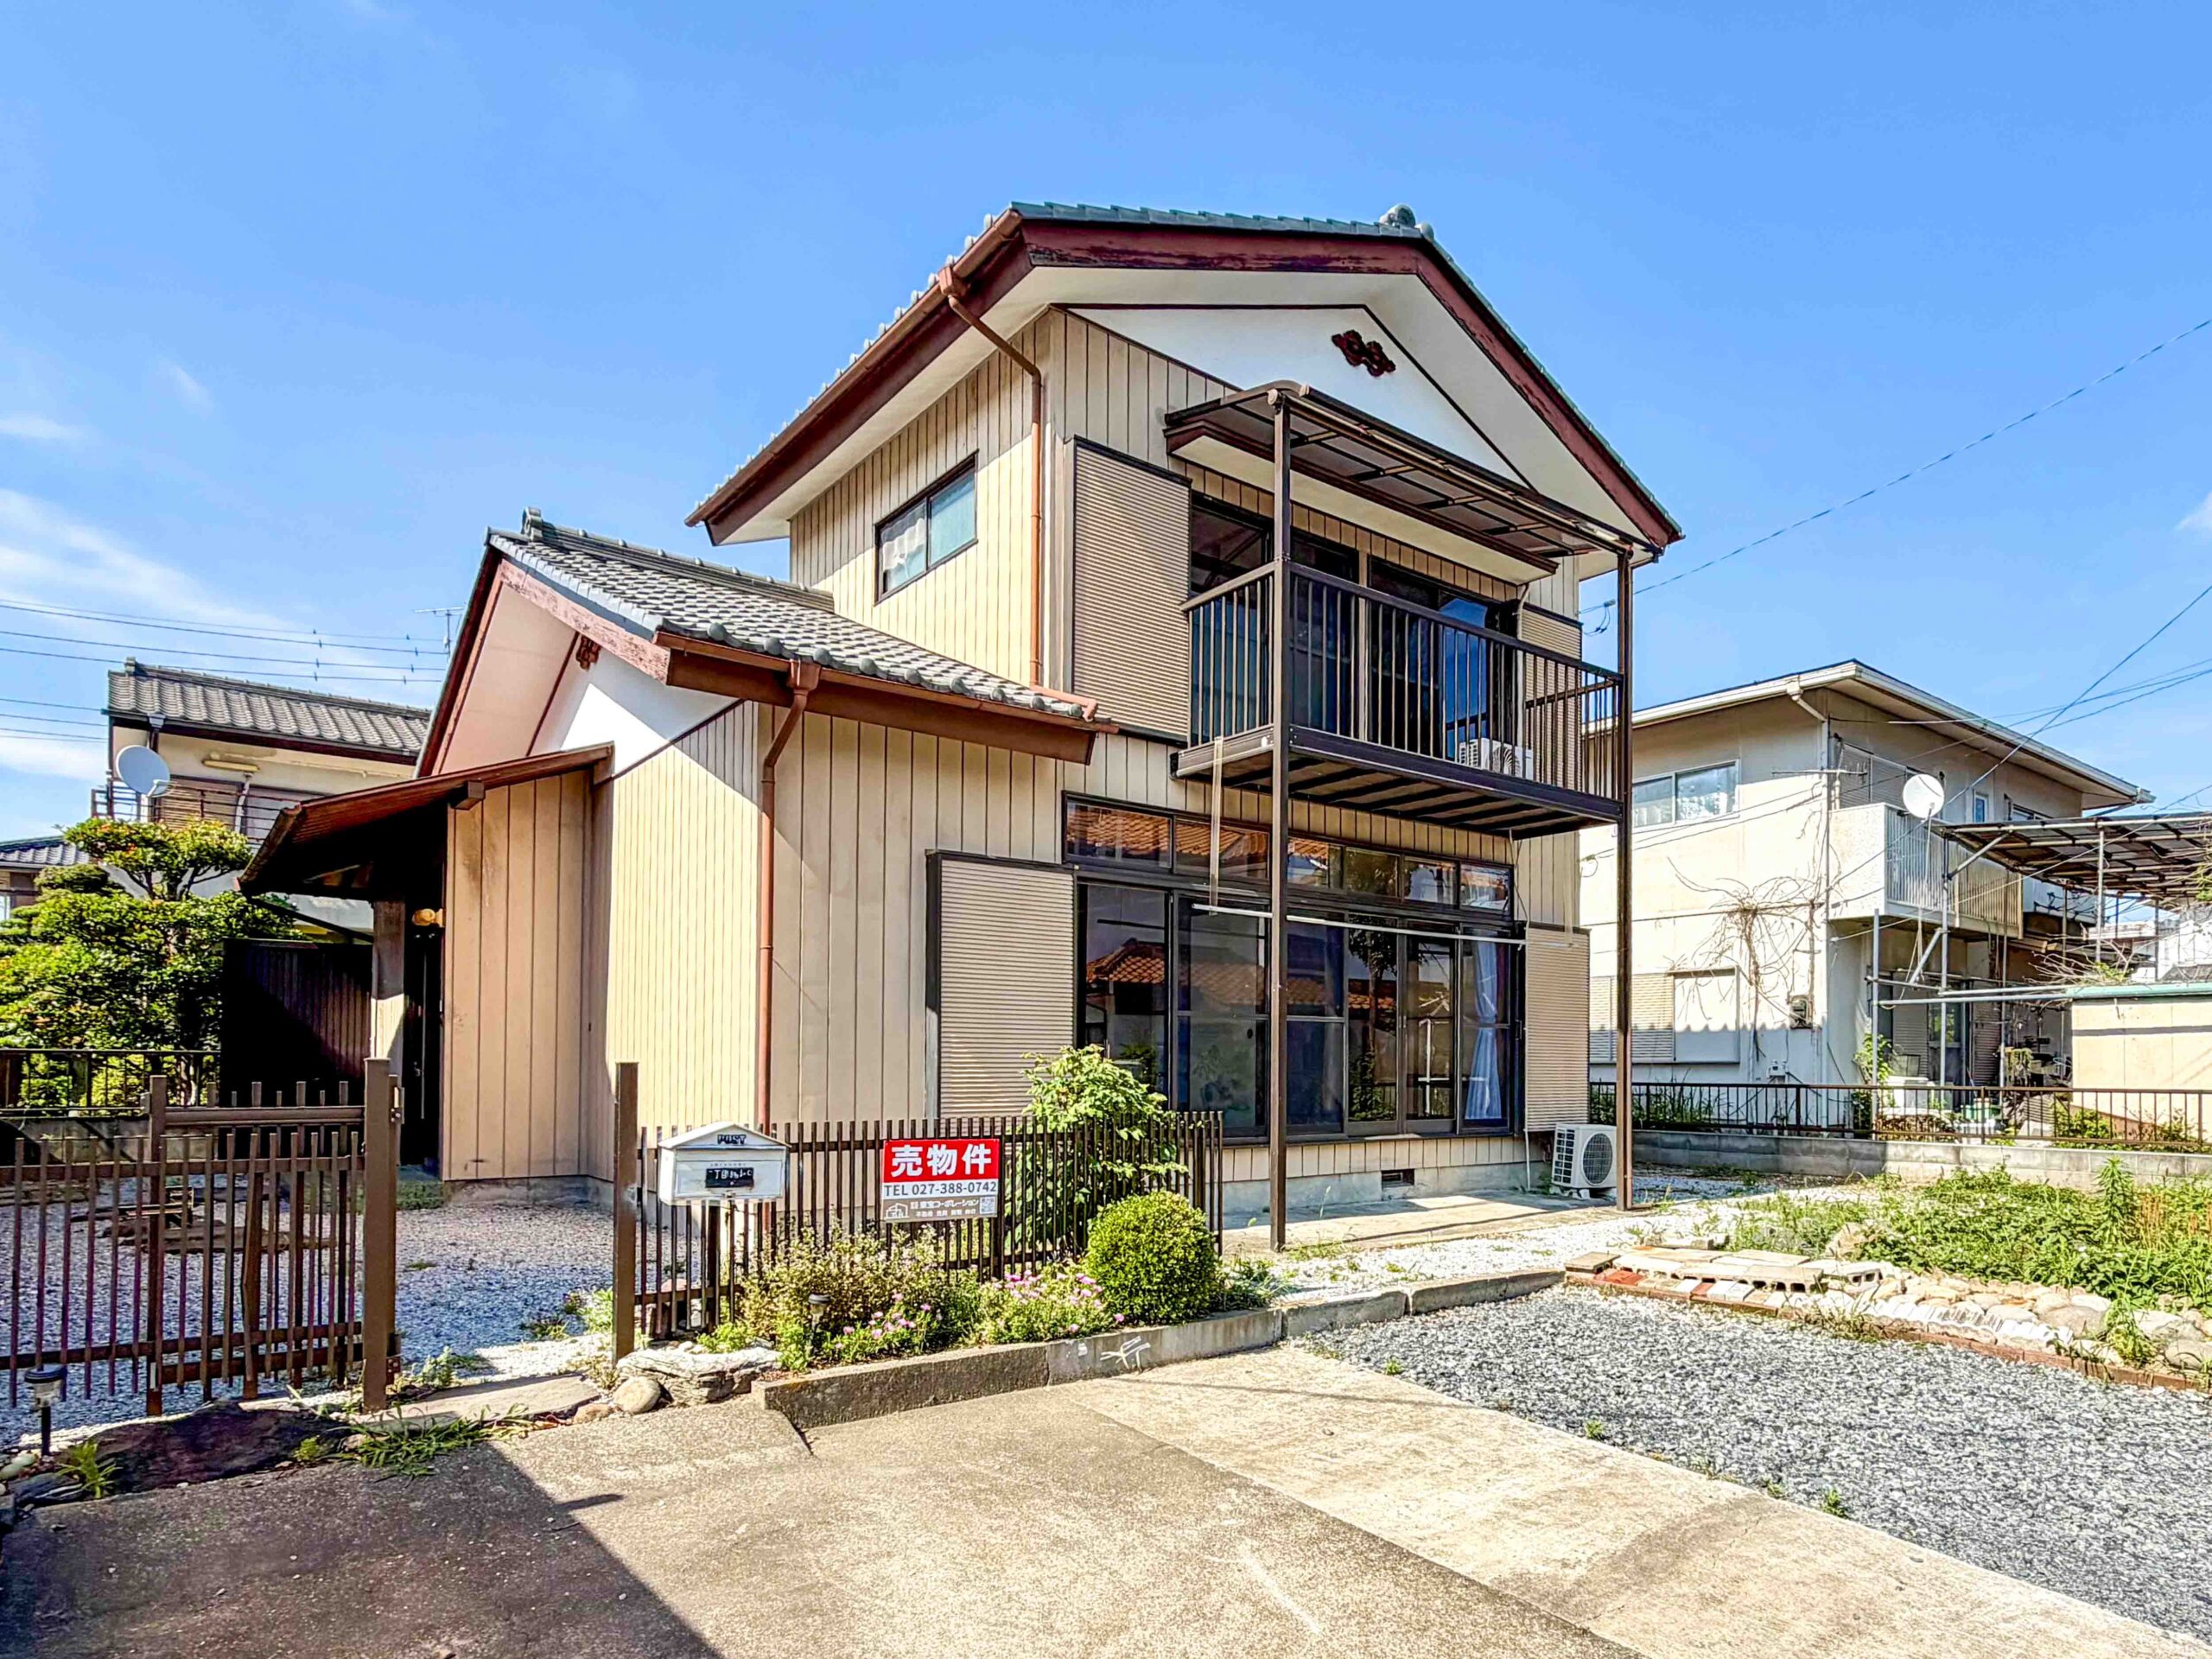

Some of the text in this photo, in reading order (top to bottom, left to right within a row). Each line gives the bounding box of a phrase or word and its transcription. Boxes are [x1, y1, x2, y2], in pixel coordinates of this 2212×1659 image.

[890, 1143, 992, 1178] 売物件
[884, 1181, 996, 1197] TEL 027-388-0742
